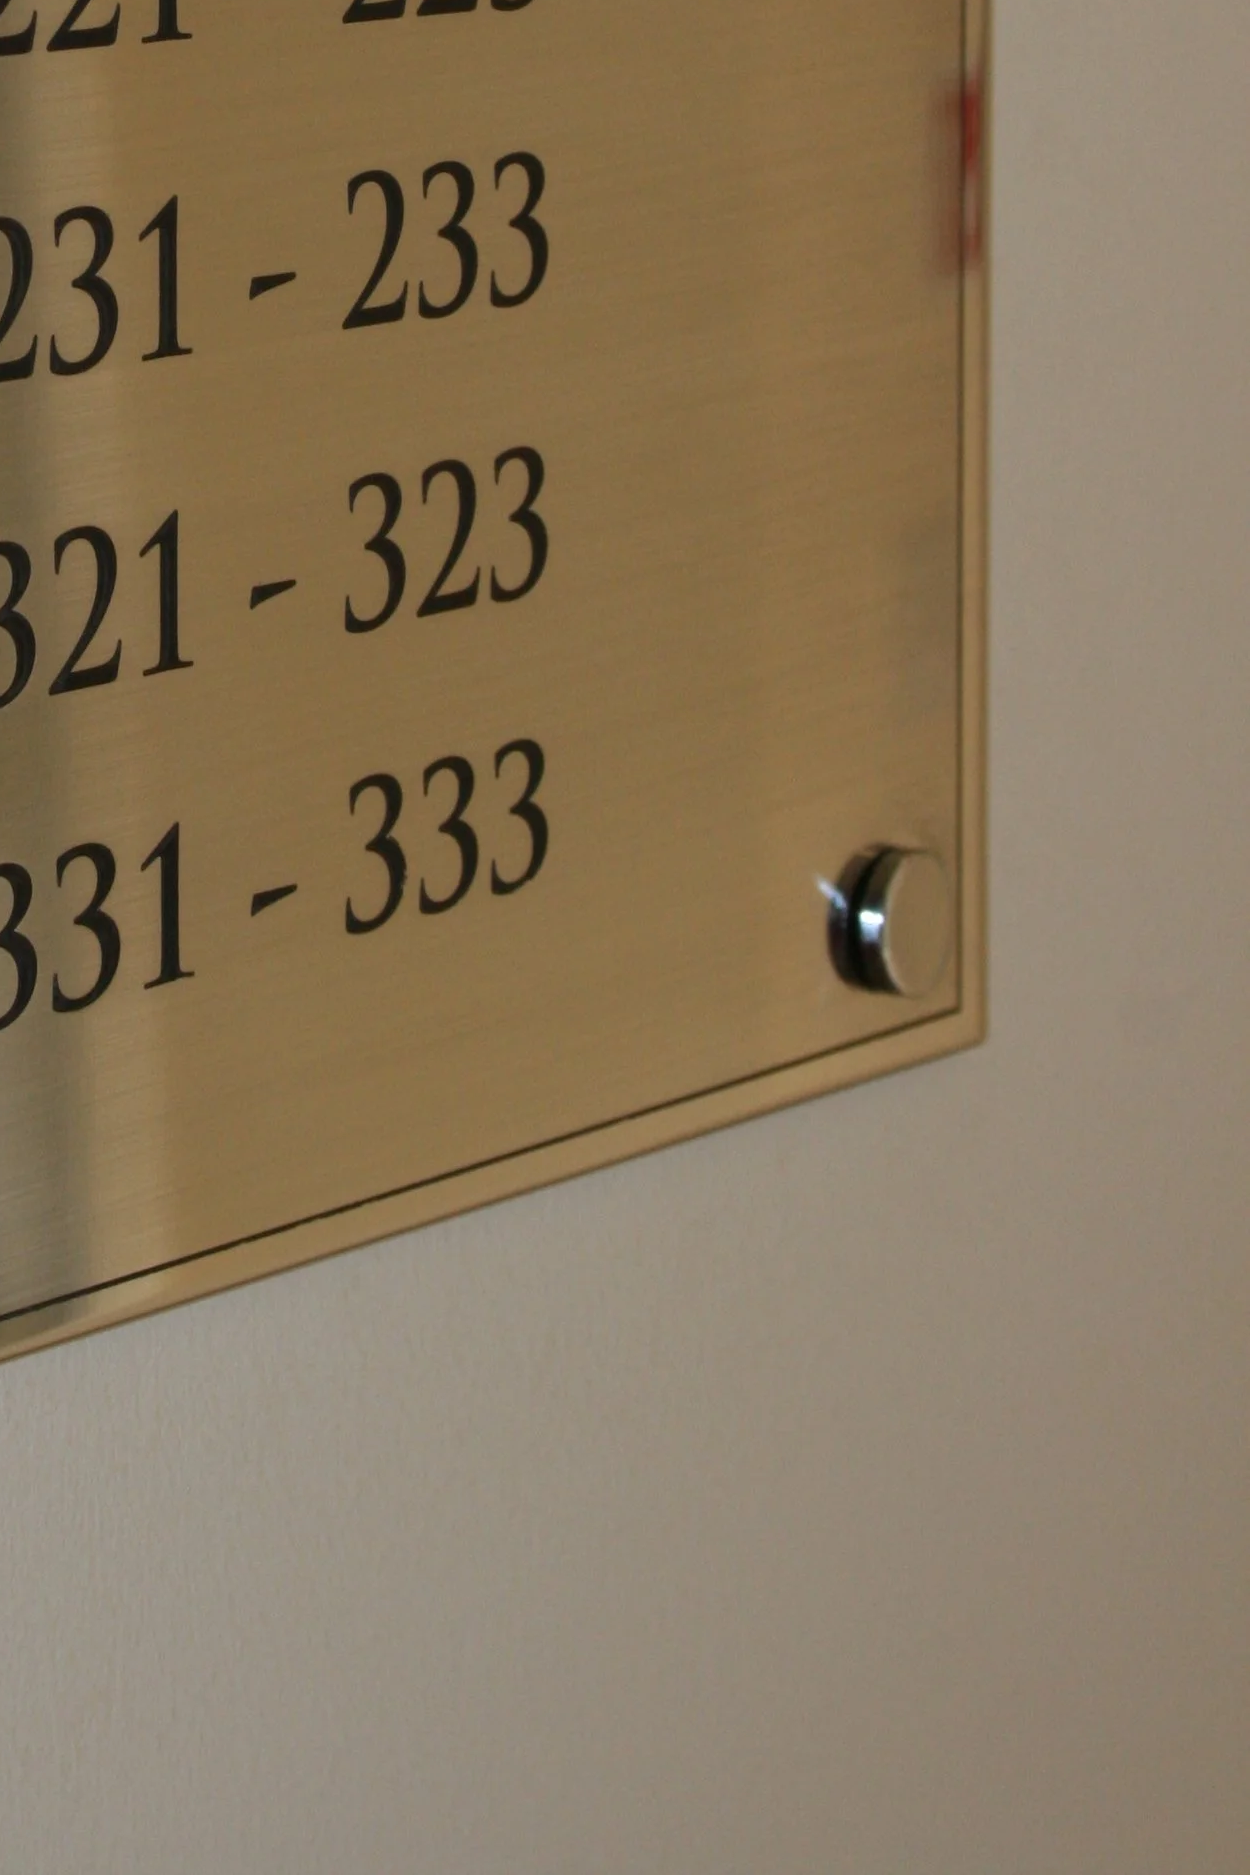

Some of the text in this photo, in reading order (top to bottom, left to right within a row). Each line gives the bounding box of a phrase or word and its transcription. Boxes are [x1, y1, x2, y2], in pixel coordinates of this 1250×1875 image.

[247, 270, 298, 302] -
[340, 150, 550, 331] 233
[247, 578, 298, 611] -
[342, 445, 550, 635] 323
[248, 883, 299, 918] -
[343, 738, 550, 936] 333
